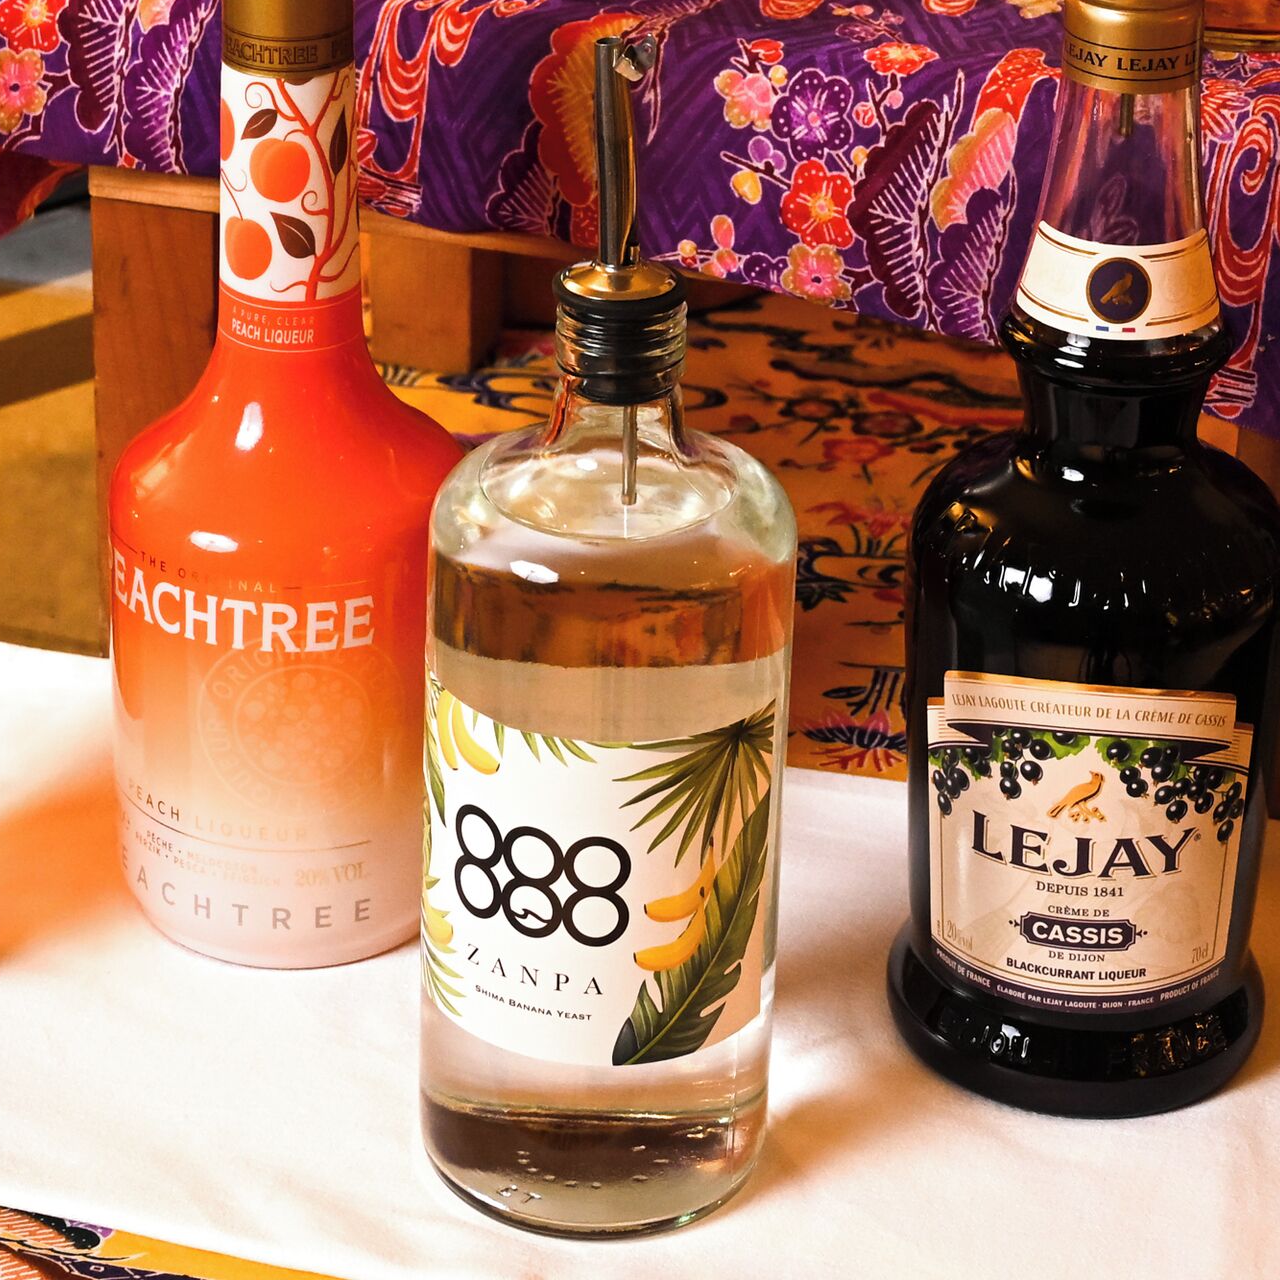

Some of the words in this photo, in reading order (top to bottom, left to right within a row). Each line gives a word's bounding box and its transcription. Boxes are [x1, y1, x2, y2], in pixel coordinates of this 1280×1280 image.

[1116, 55, 1180, 72] LEJAY
[231, 318, 261, 341] PEACH
[264, 328, 315, 345] LIQUEUR
[140, 551, 167, 572] THE
[113, 546, 375, 653] EACHTREE
[951, 693, 977, 707] LEJAY
[978, 694, 1027, 712] LAGOUTE
[1096, 707, 1112, 719] DE
[1116, 708, 1131, 720] LA
[1178, 713, 1193, 726] DE
[1194, 713, 1227, 728] CASSIS
[128, 778, 180, 822] PEACH
[972, 809, 1198, 881] LEJAY
[454, 803, 632, 947] 888
[1036, 880, 1089, 897] DEPUIS
[1093, 886, 1124, 897] 1841
[1047, 904, 1090, 917] CRÈME
[1093, 909, 1110, 917] DE
[1032, 921, 1124, 945] CASSIS
[467, 943, 604, 996] ZANPA
[936, 948, 957, 970] PRODUIT
[957, 964, 966, 976] DE
[965, 970, 991, 988] FRANCE
[1006, 957, 1096, 980] BLACKCURRANT
[1098, 968, 1147, 982] LIQUEUR
[1048, 950, 1065, 960] DE
[1068, 953, 1106, 962] DIJON
[996, 984, 1027, 1000] ÉLABORÉ
[1027, 993, 1042, 1003] PAR
[1042, 997, 1064, 1007] LEJAY
[1064, 1000, 1097, 1009] LAGOUTE
[1102, 1001, 1123, 1009] DIJON
[1128, 996, 1154, 1007] FRANCE
[1160, 984, 1191, 1001] PRODUCT
[1191, 980, 1200, 991] OF
[1200, 967, 1221, 986] FRANCE
